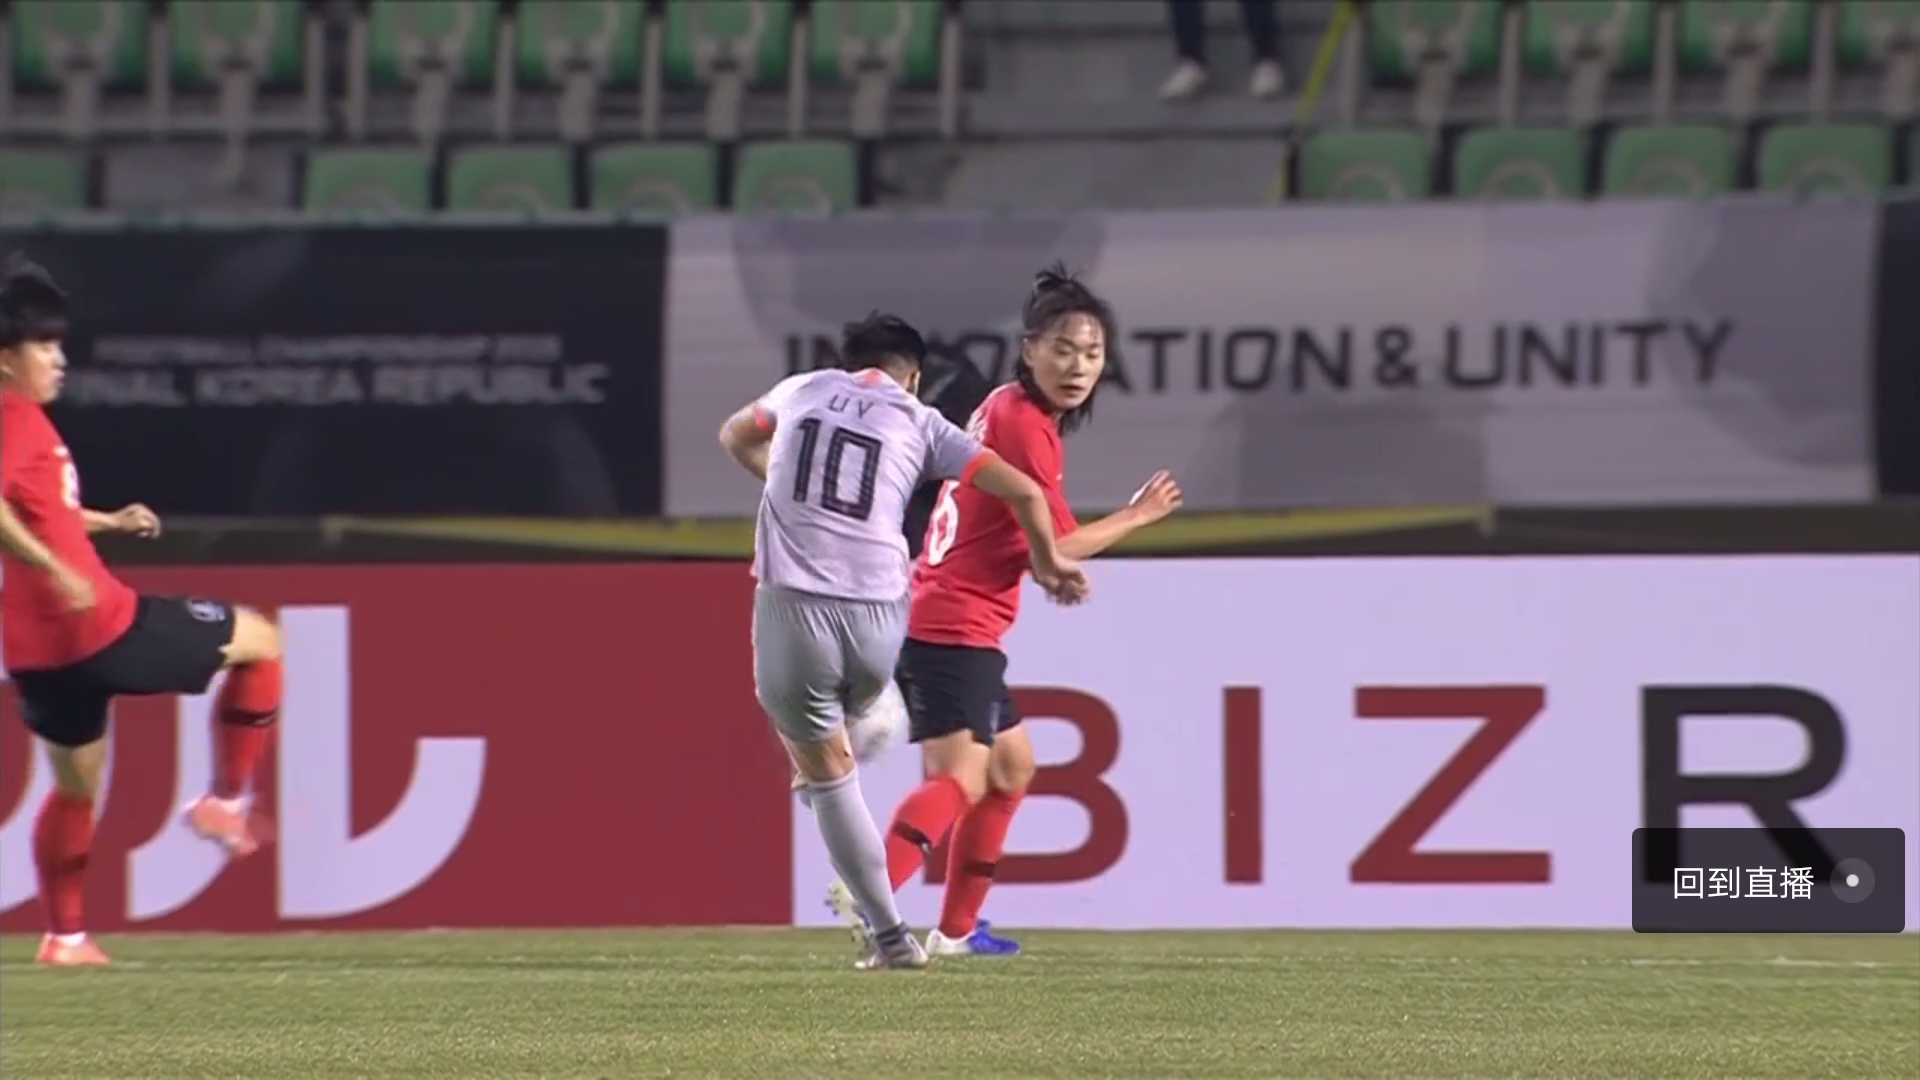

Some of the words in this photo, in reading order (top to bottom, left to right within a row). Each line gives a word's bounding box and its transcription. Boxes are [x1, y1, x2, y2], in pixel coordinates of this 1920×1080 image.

[194, 368, 364, 407] KOREA
[371, 363, 609, 406] REPUBLIC
[1373, 325, 1419, 389] &
[1442, 317, 1736, 390] UNITY
[792, 417, 883, 522] 10
